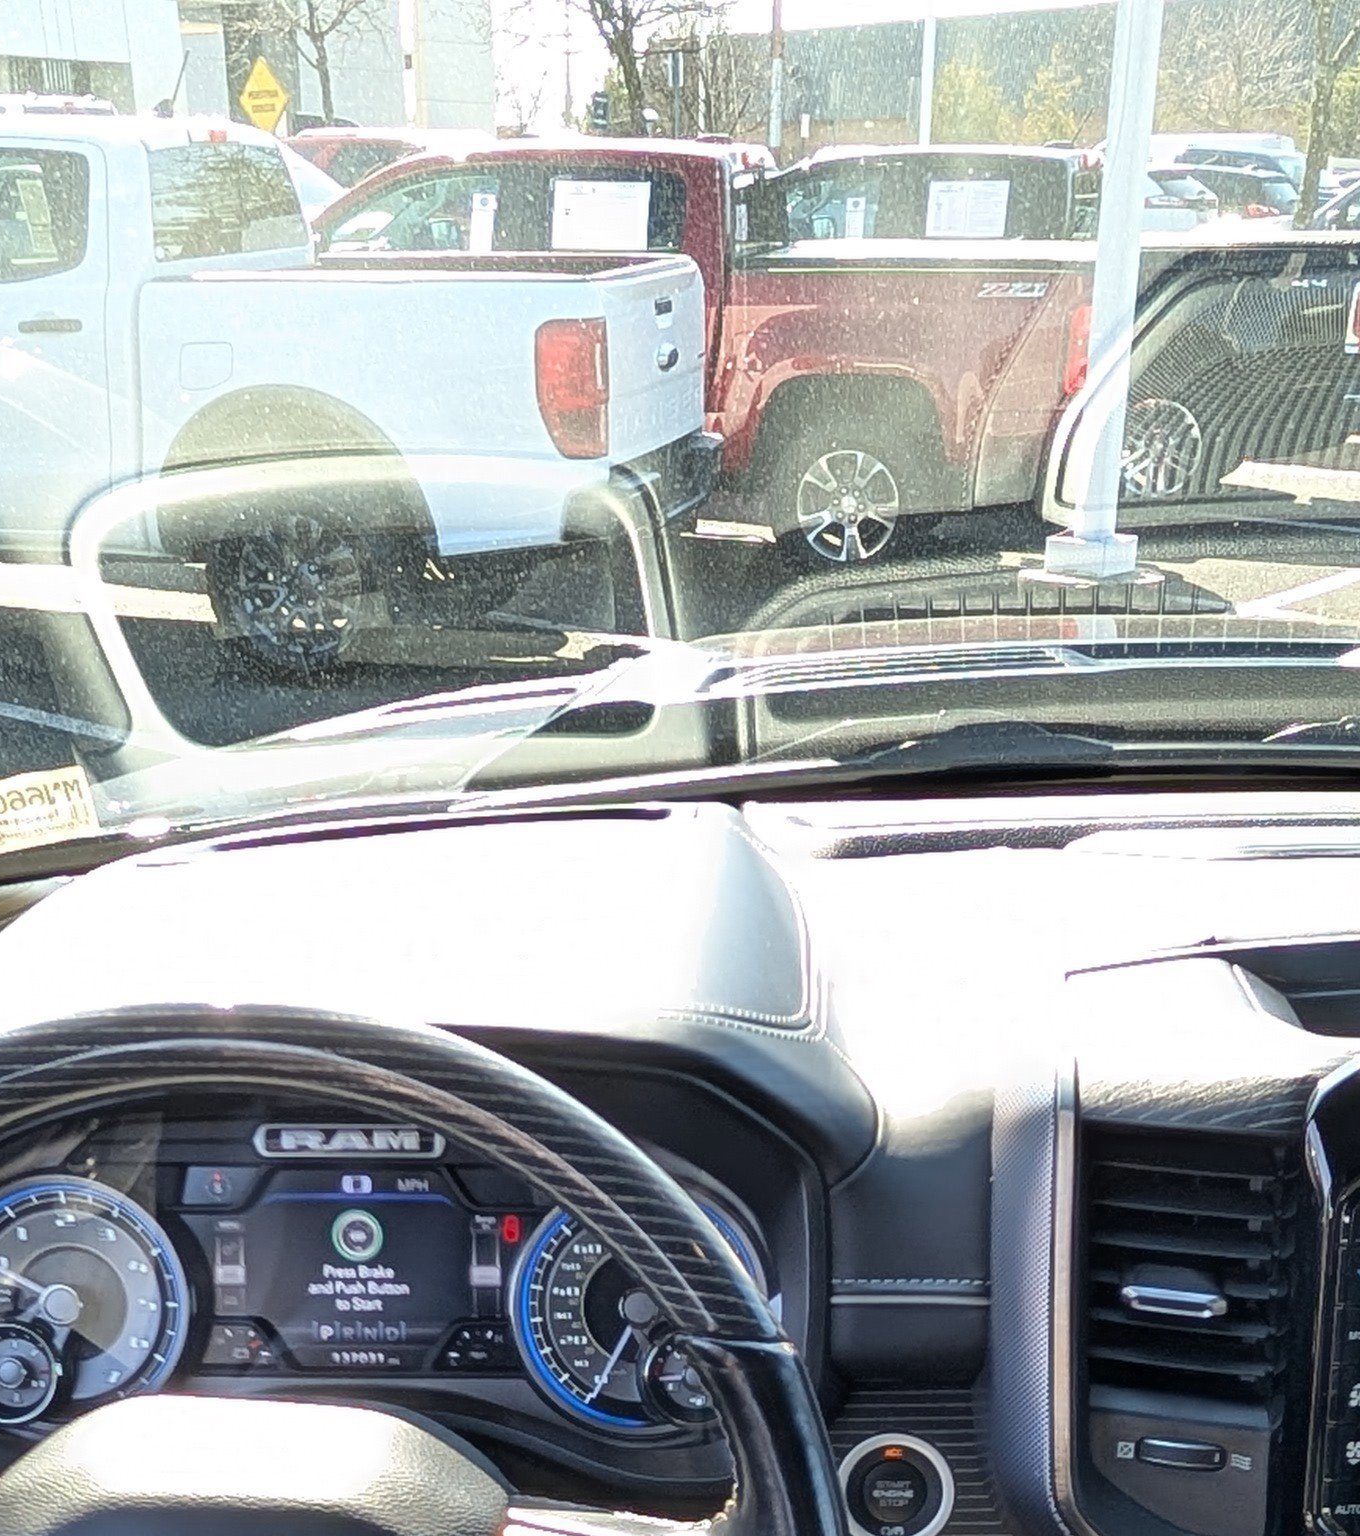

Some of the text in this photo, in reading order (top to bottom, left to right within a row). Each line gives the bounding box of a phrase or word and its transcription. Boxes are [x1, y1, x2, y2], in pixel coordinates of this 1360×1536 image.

[280, 1129, 420, 1150] RAM
[397, 1178, 430, 1192] MPH
[322, 1263, 395, 1279] Press Brake
[308, 1280, 410, 1296] and Push Button
[335, 1297, 383, 1312] to Start
[876, 1480, 911, 1489] START
